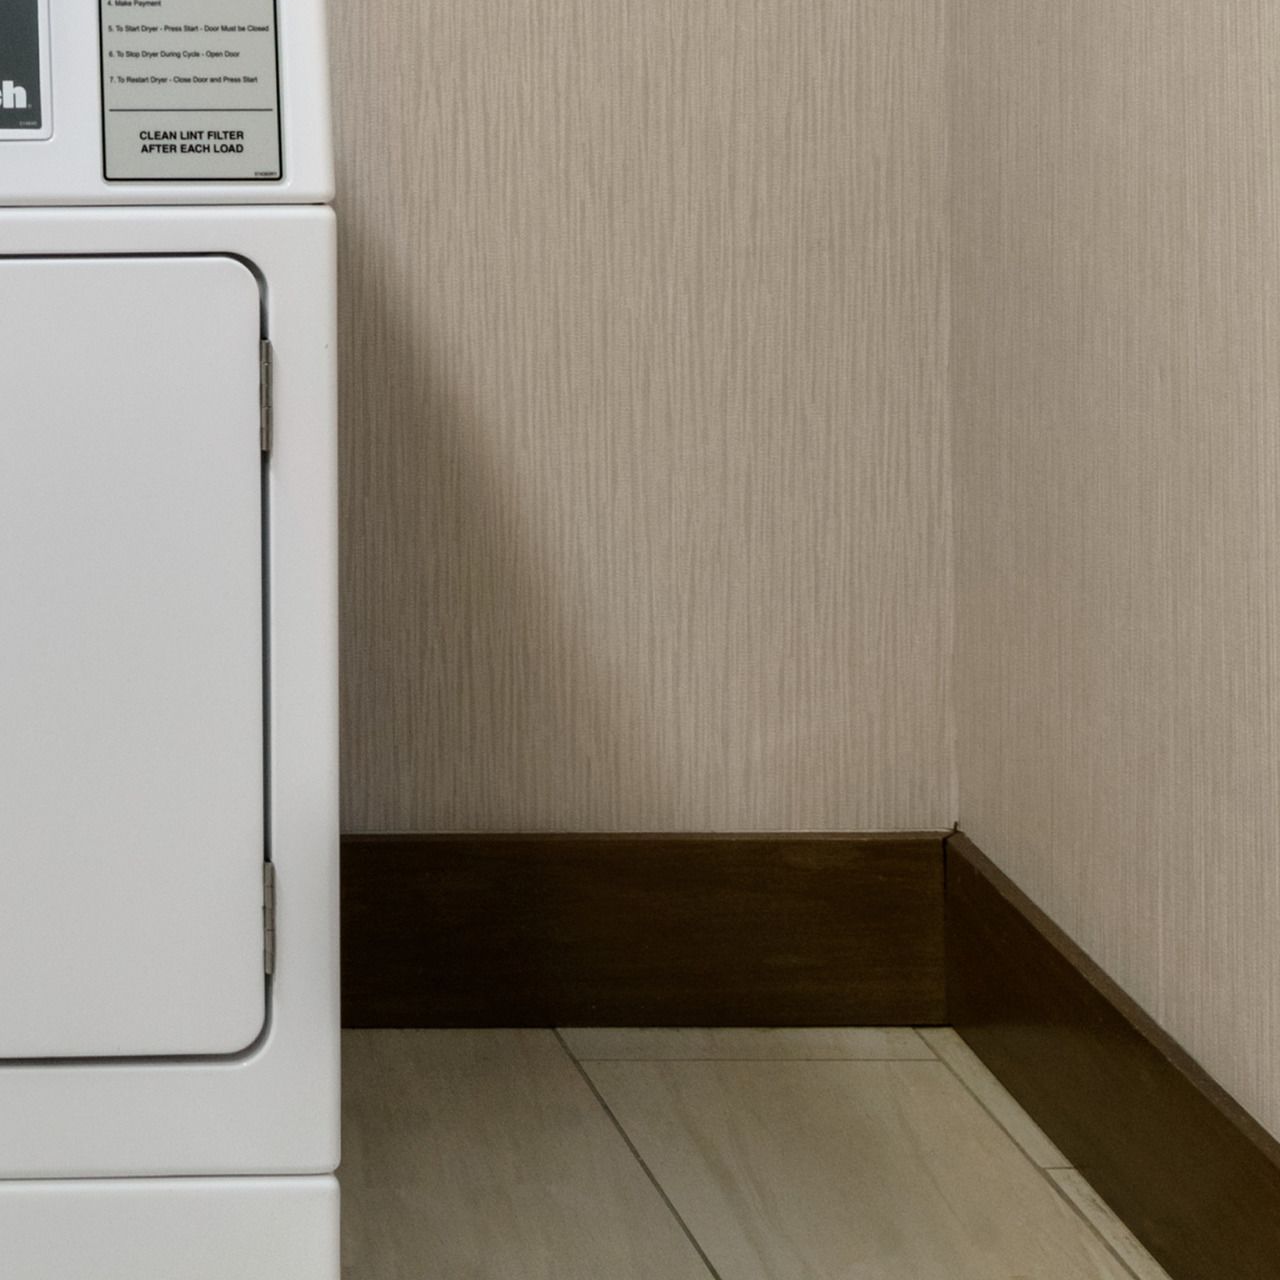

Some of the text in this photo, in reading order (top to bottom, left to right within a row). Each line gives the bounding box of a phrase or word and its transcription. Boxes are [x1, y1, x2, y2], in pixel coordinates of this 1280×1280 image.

[134, 0, 161, 8] Payment
[142, 51, 158, 59] Dryer
[140, 131, 244, 140] CLEAN LINT FILTER
[141, 144, 244, 153] AFTER EACH LOAD
